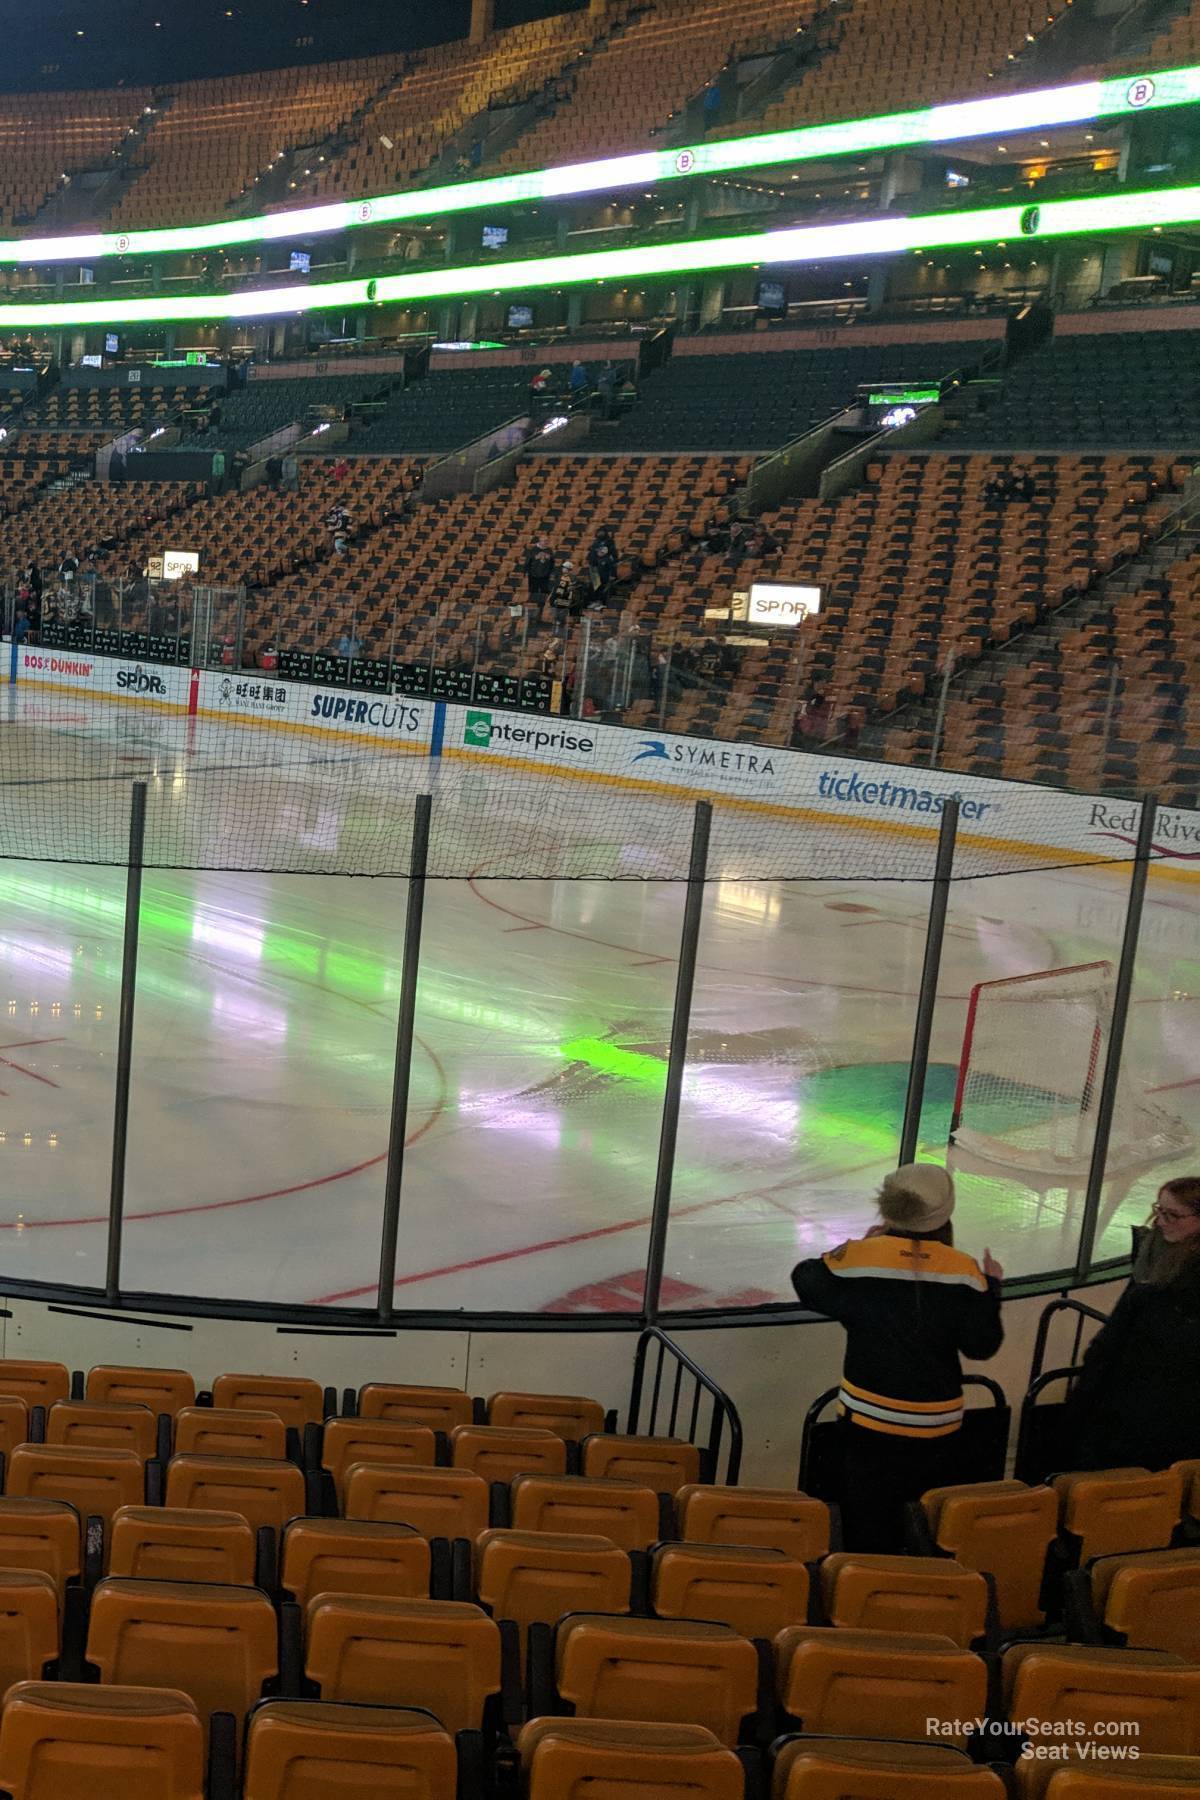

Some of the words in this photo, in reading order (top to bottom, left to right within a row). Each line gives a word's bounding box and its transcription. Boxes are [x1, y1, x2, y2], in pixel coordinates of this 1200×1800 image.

[311, 694, 420, 732] SUPERCUTS
[674, 745, 775, 775] SYMETRA
[1087, 803, 1140, 832] Red
